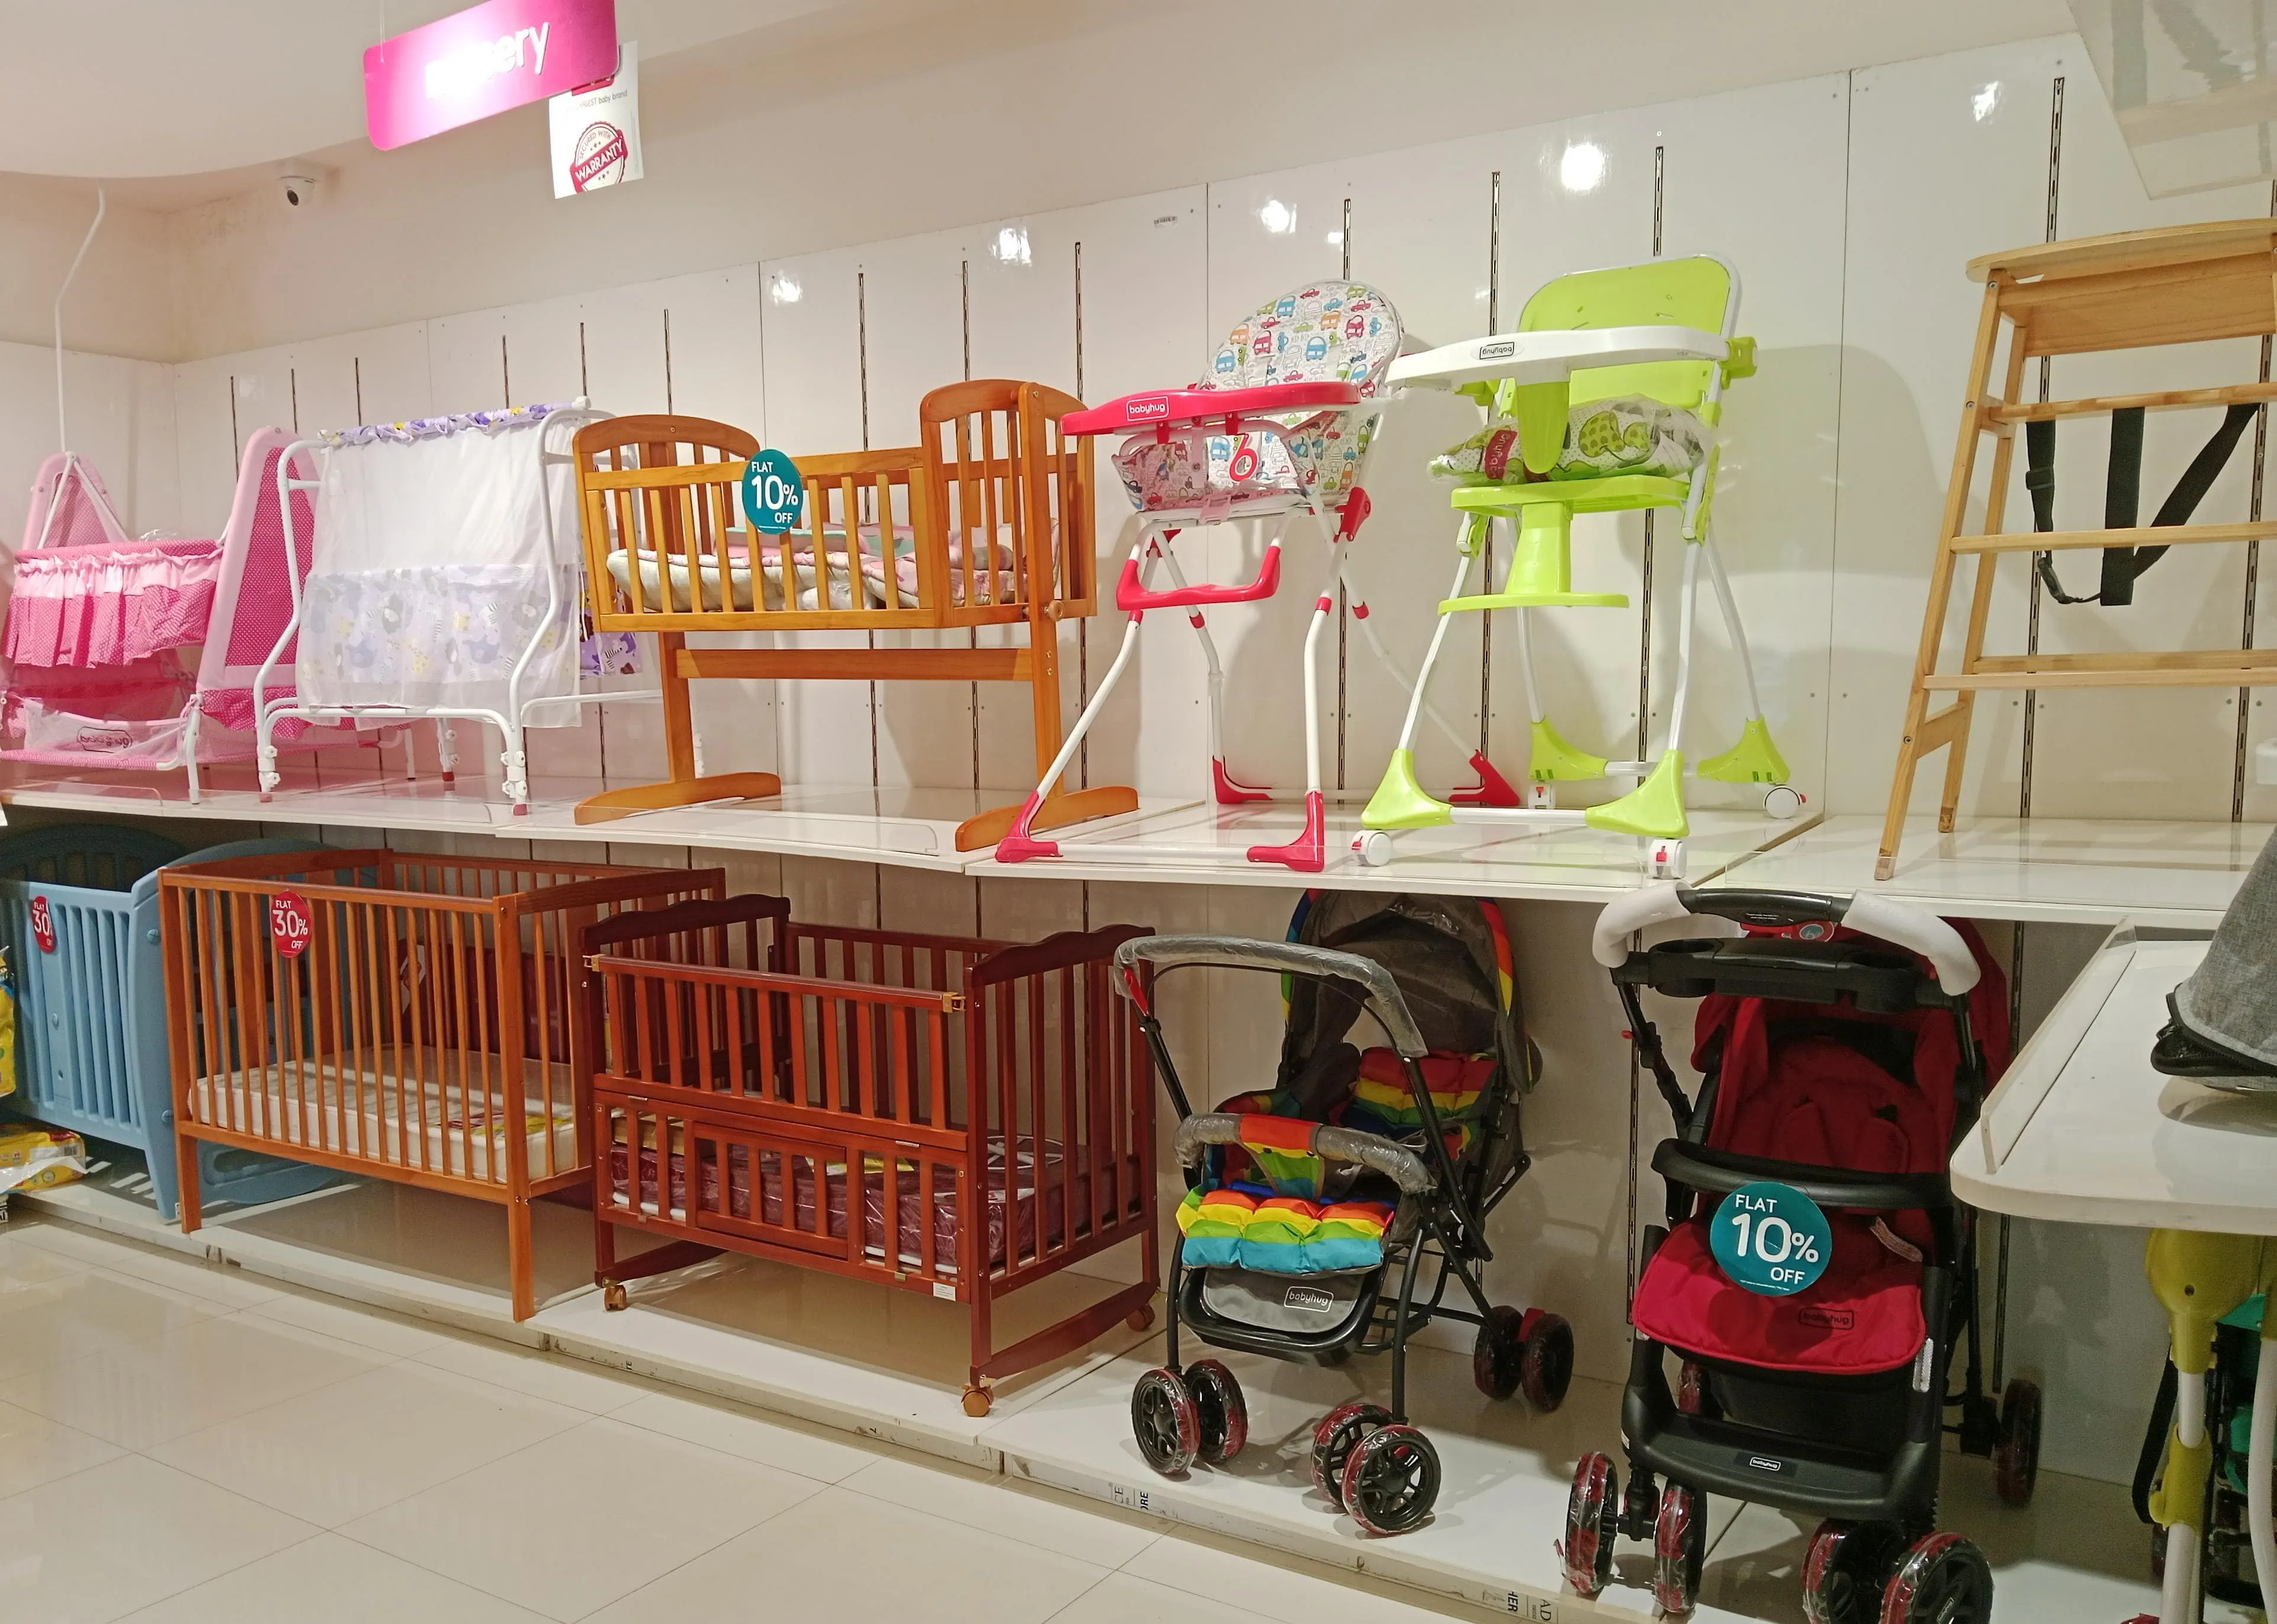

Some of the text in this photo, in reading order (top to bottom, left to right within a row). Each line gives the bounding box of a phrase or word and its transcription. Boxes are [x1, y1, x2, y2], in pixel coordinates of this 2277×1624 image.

[599, 95, 611, 104] baby
[612, 89, 628, 101] brand
[580, 130, 612, 159] SECURED WITH
[575, 138, 623, 183] WARRANTY
[1482, 346, 1512, 355] babyhug
[1128, 402, 1166, 415] babyhug
[751, 461, 773, 473] FLAT
[751, 475, 799, 510] 10%
[774, 512, 793, 524] OFF
[276, 900, 292, 909] FLAT
[33, 910, 53, 936] 30
[273, 910, 308, 937] 30%
[291, 940, 303, 949] OFF
[1735, 1193, 1778, 1213] FLAT
[1732, 1213, 1819, 1263] 10%
[1770, 1267, 1806, 1285] OFF
[1289, 1291, 1328, 1306] babyhug
